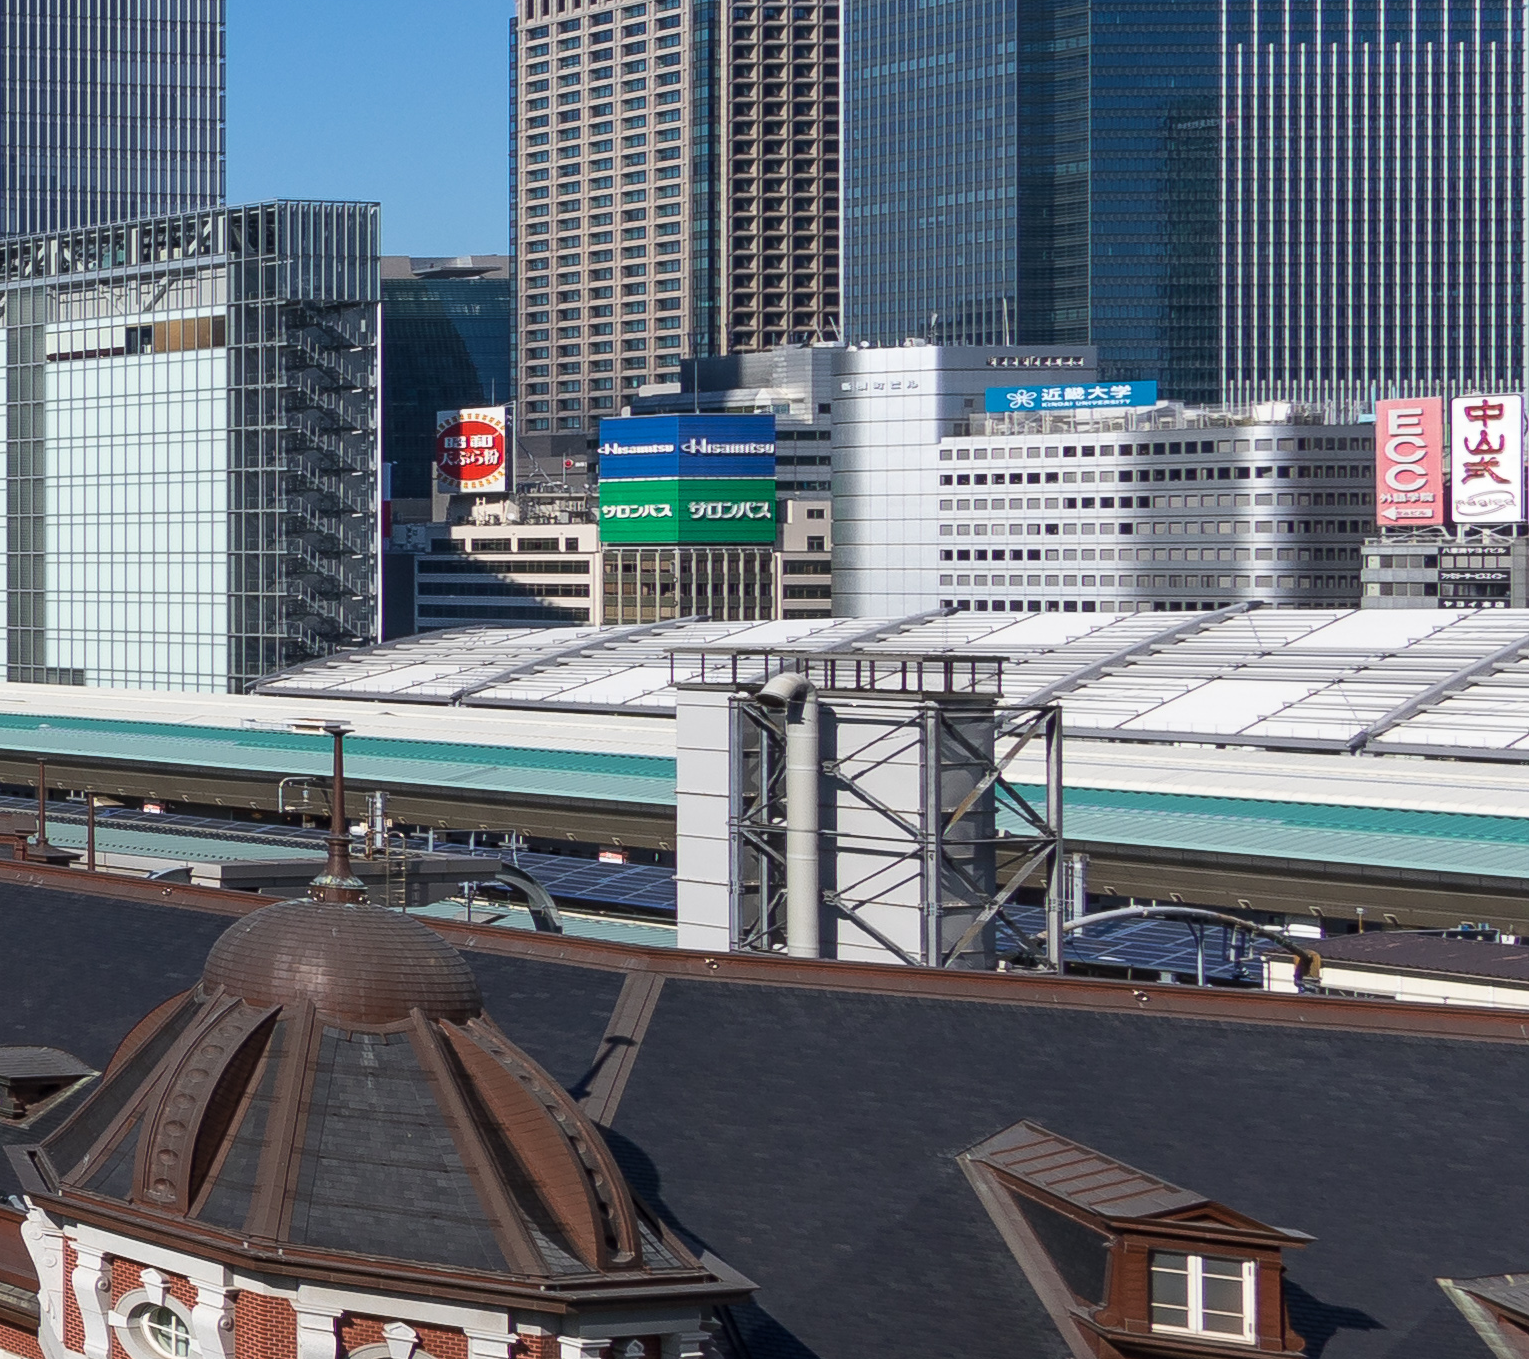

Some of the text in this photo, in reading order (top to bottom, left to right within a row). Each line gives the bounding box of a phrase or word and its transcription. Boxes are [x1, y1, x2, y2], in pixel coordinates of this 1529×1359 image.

[1041, 385, 1132, 401] 近畿大学
[1041, 398, 1131, 408] KINDAI UNIVERSITY
[444, 434, 494, 449] 昭和
[597, 443, 674, 455] Hisamitsu
[681, 438, 775, 454] Hisamitsu
[1461, 398, 1512, 485] 中山式
[440, 449, 500, 466] 天ぷら粉
[1384, 408, 1428, 492] ECC
[602, 503, 673, 519] サロンパス
[688, 501, 772, 519] サロンパス
